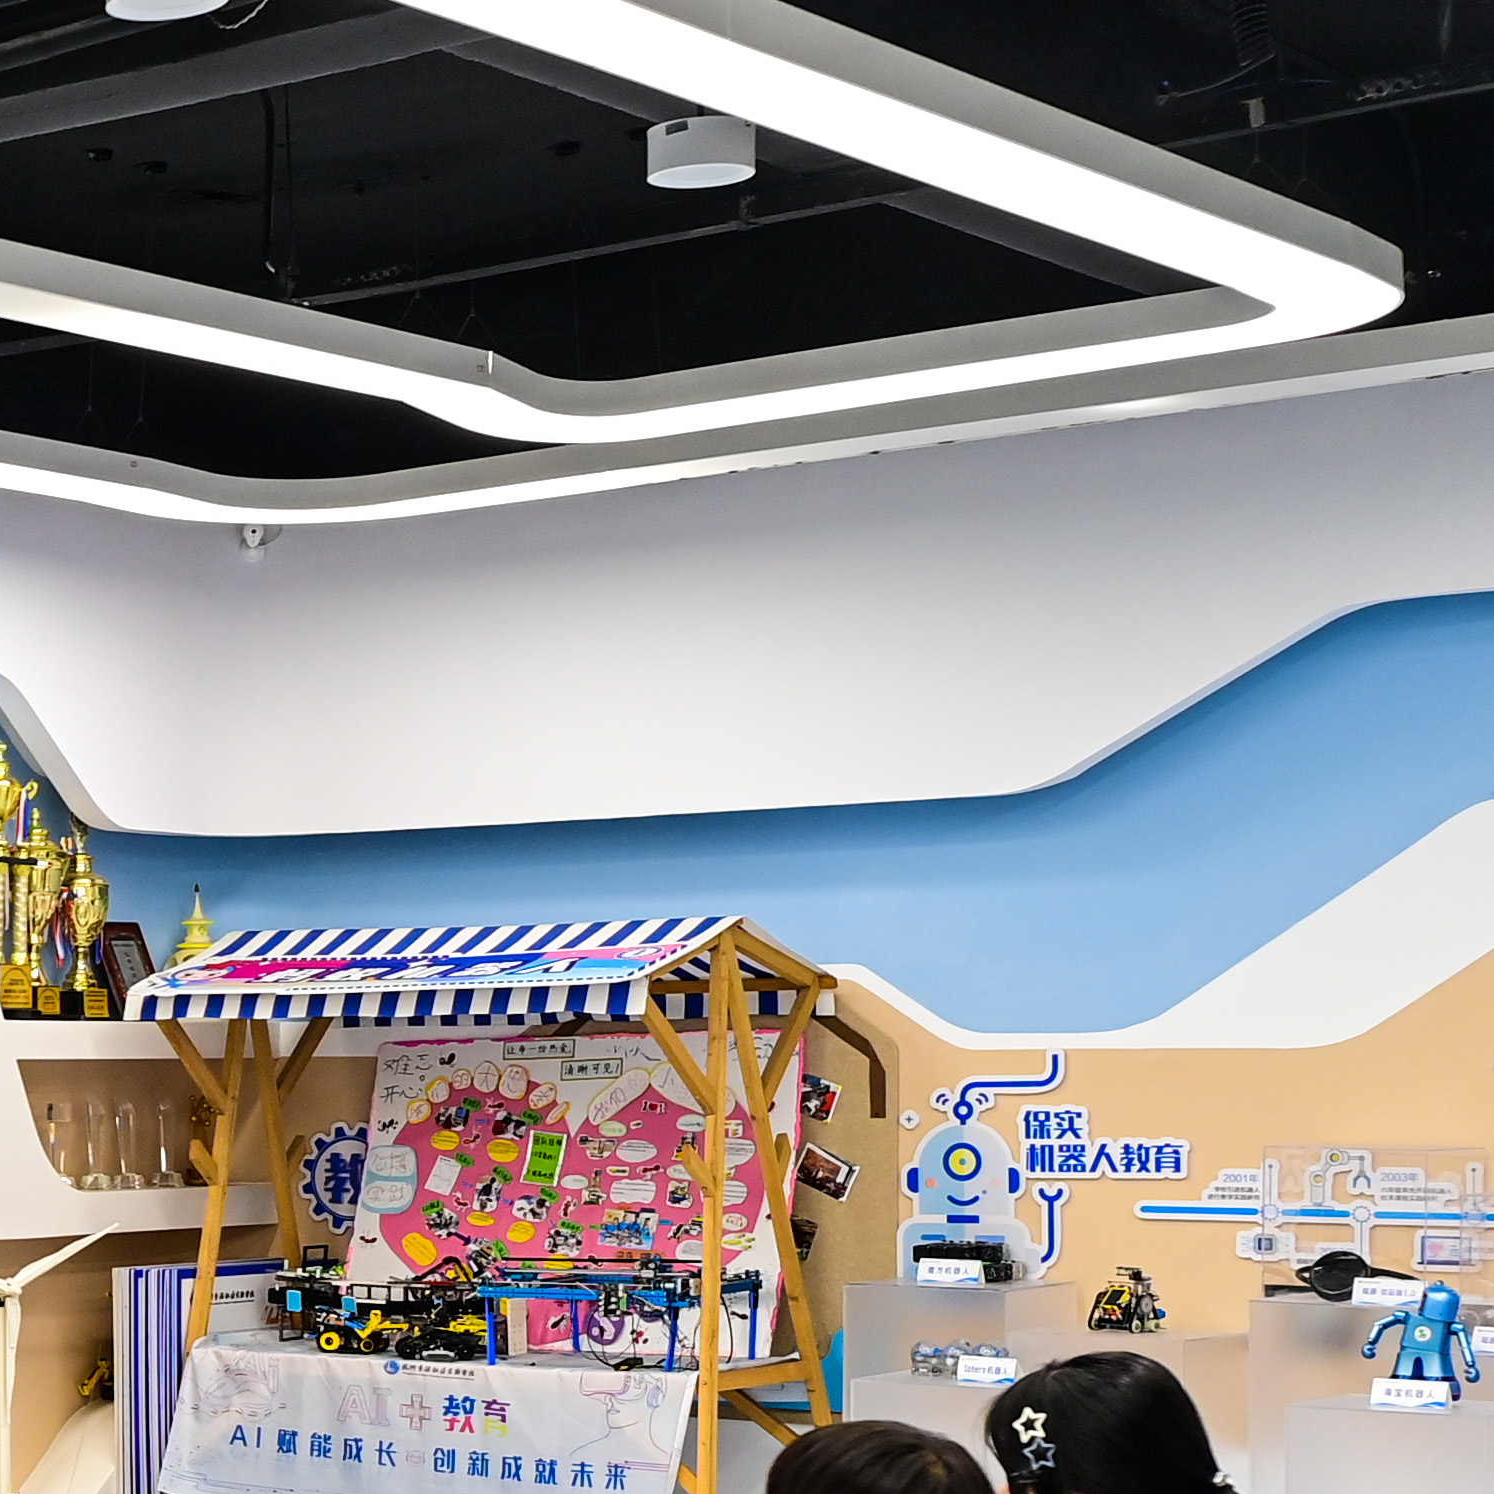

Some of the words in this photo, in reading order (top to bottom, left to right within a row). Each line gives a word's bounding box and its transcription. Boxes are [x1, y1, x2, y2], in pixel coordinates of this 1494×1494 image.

[1023, 1110, 1083, 1140] 保实
[1025, 1143, 1183, 1174] 机器人教育
[1223, 1173, 1259, 1184] 2001年
[432, 1447, 632, 1490] 创新成就未来
